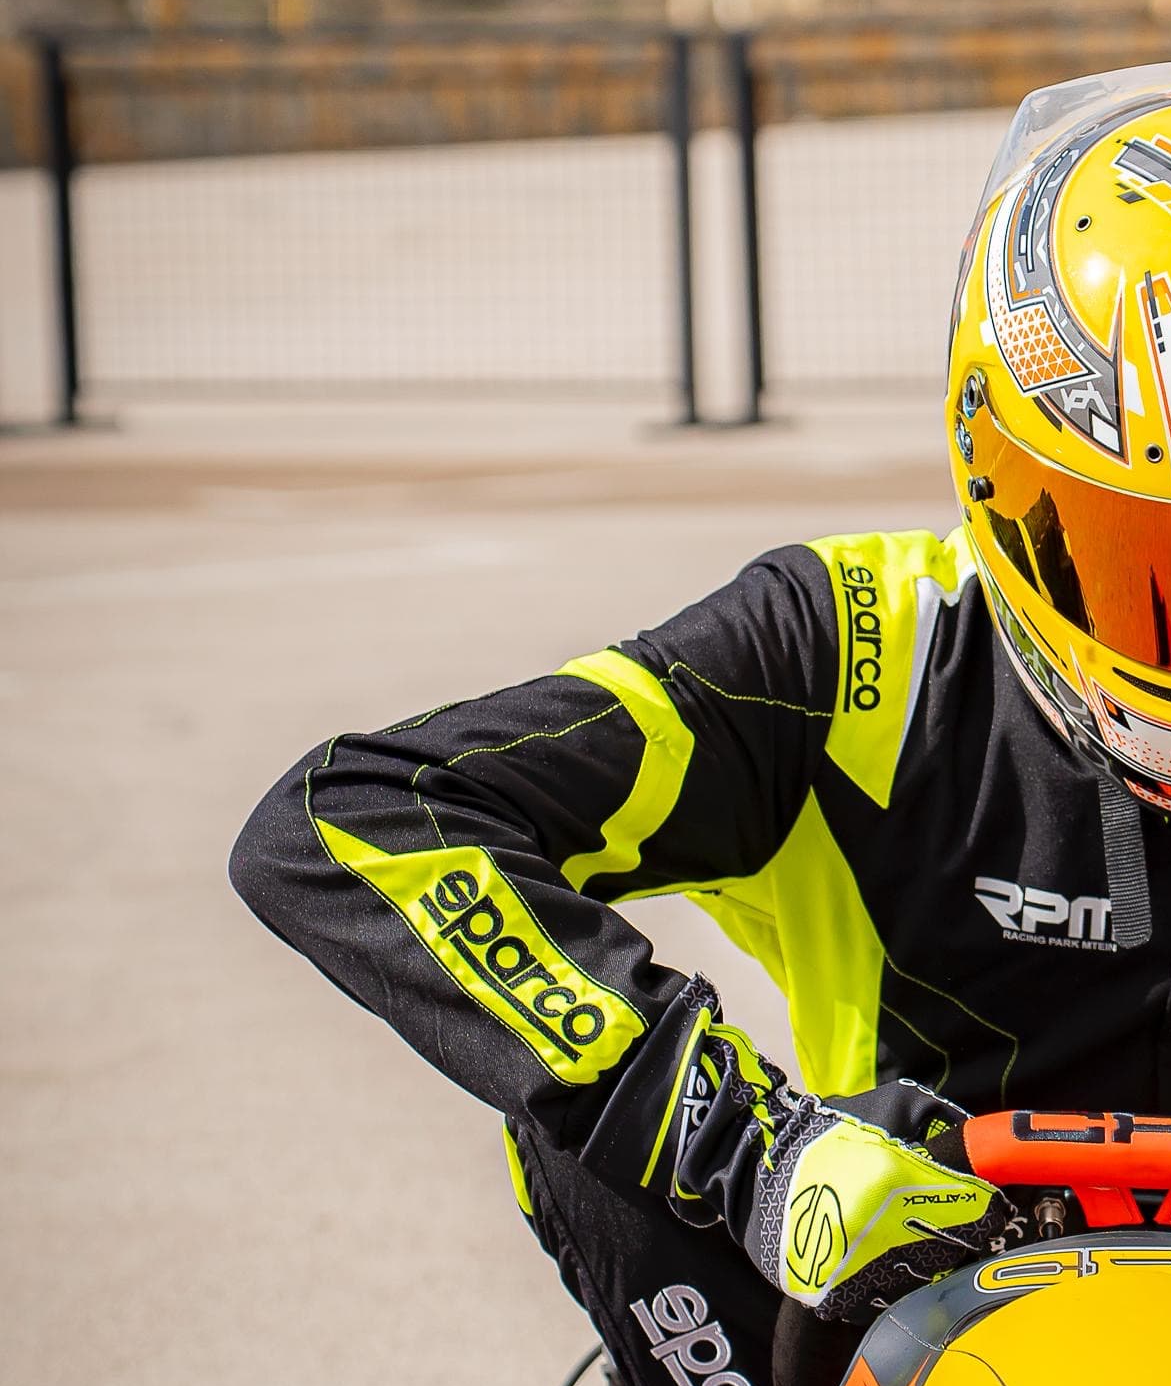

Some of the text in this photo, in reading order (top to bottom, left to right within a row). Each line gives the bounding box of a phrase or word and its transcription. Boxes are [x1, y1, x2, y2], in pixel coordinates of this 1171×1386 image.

[840, 563, 882, 712] sparco
[427, 869, 605, 1061] sparco
[1002, 929, 1046, 945] RACING
[1048, 936, 1080, 948] PARK
